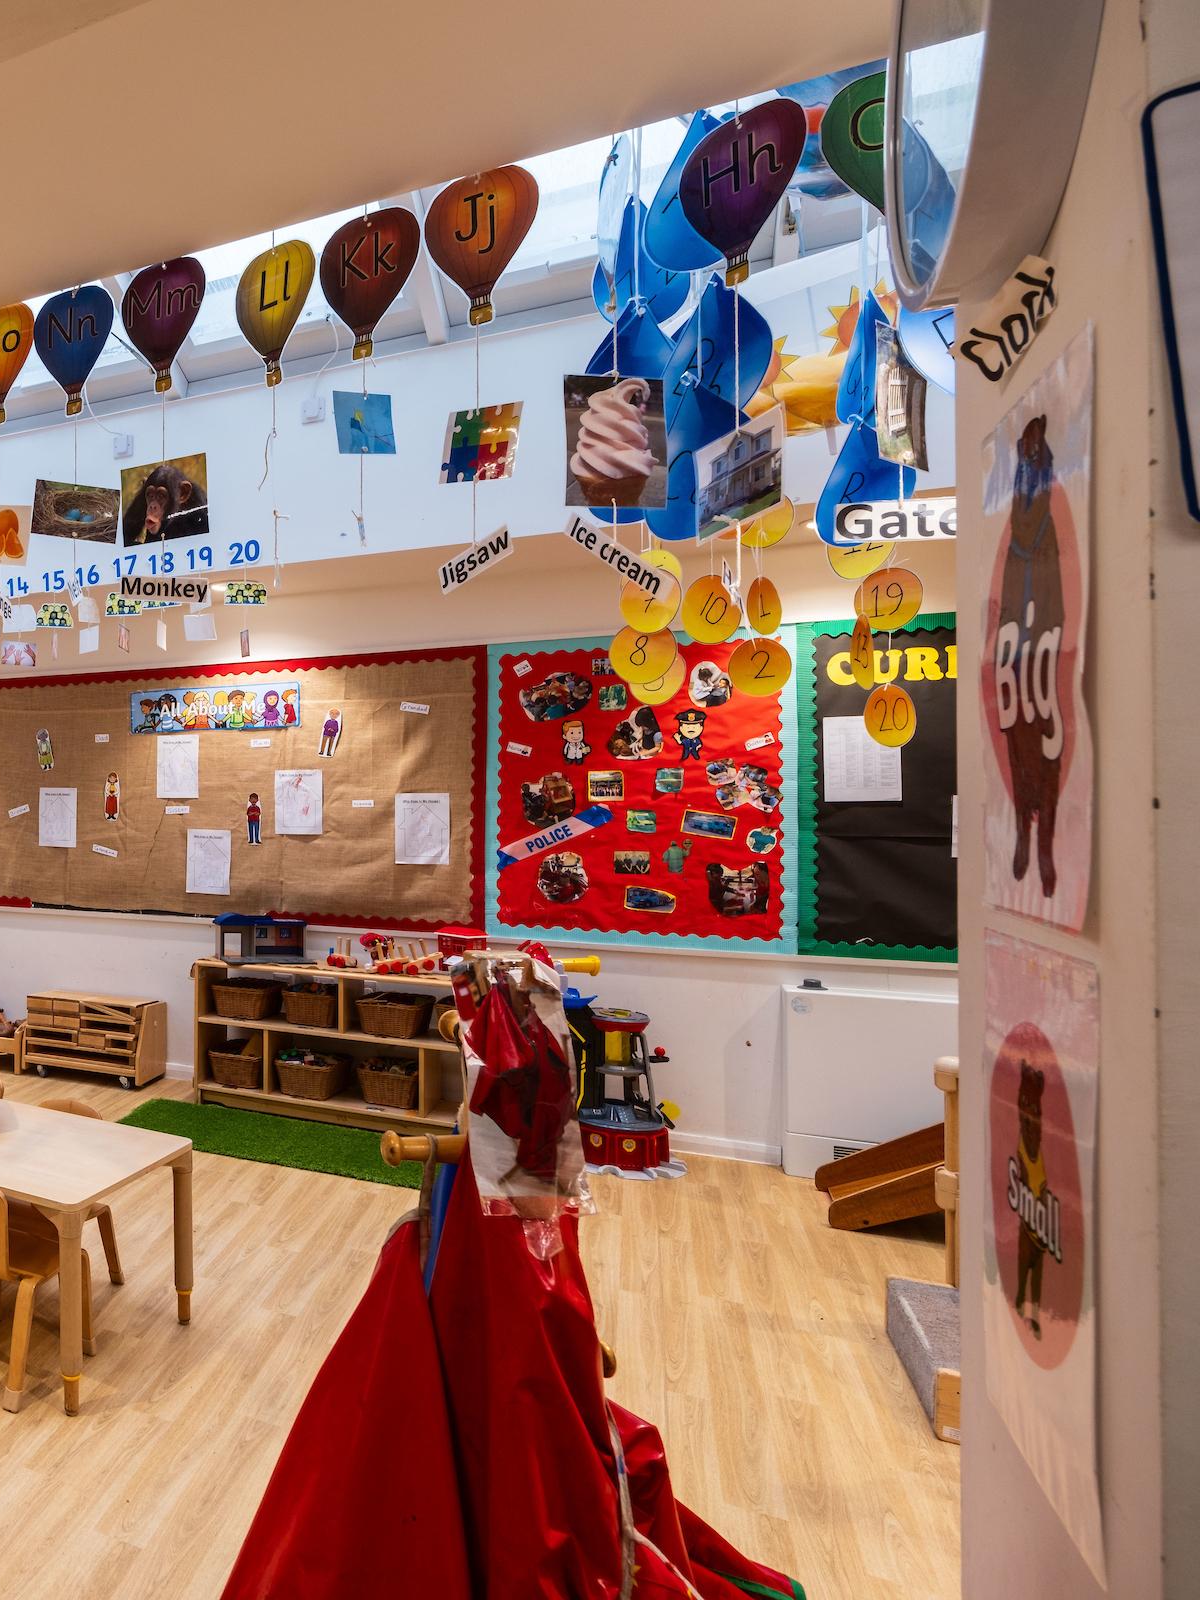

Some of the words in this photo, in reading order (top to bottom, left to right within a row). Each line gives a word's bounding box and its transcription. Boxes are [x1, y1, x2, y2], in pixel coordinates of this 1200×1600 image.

[703, 133, 783, 208] Hh
[455, 192, 496, 254] Jj
[341, 232, 398, 288] Kk
[260, 261, 291, 312] Ll
[126, 280, 201, 329] Mm
[48, 308, 98, 349] Nn
[113, 554, 137, 577] 17
[148, 552, 175, 575] 18
[186, 546, 212, 569] 19
[229, 539, 260, 565] 20
[442, 531, 509, 588] Jigsaw
[570, 517, 597, 551] Ice
[600, 541, 661, 595] cream
[7, 576, 29, 596] 14
[43, 570, 65, 591] 15
[75, 565, 100, 586] 16
[121, 577, 208, 602] Monkey
[700, 592, 727, 624] 10
[760, 594, 771, 618] 1
[868, 582, 904, 619] 19
[629, 635, 649, 666] 8
[751, 650, 775, 679] 2
[995, 600, 1064, 760] Big
[160, 703, 177, 718] All
[187, 702, 237, 717] About
[241, 701, 267, 714] Me
[874, 697, 909, 732] 20
[525, 824, 573, 853] POLICE
[1007, 1156, 1063, 1264] Small
